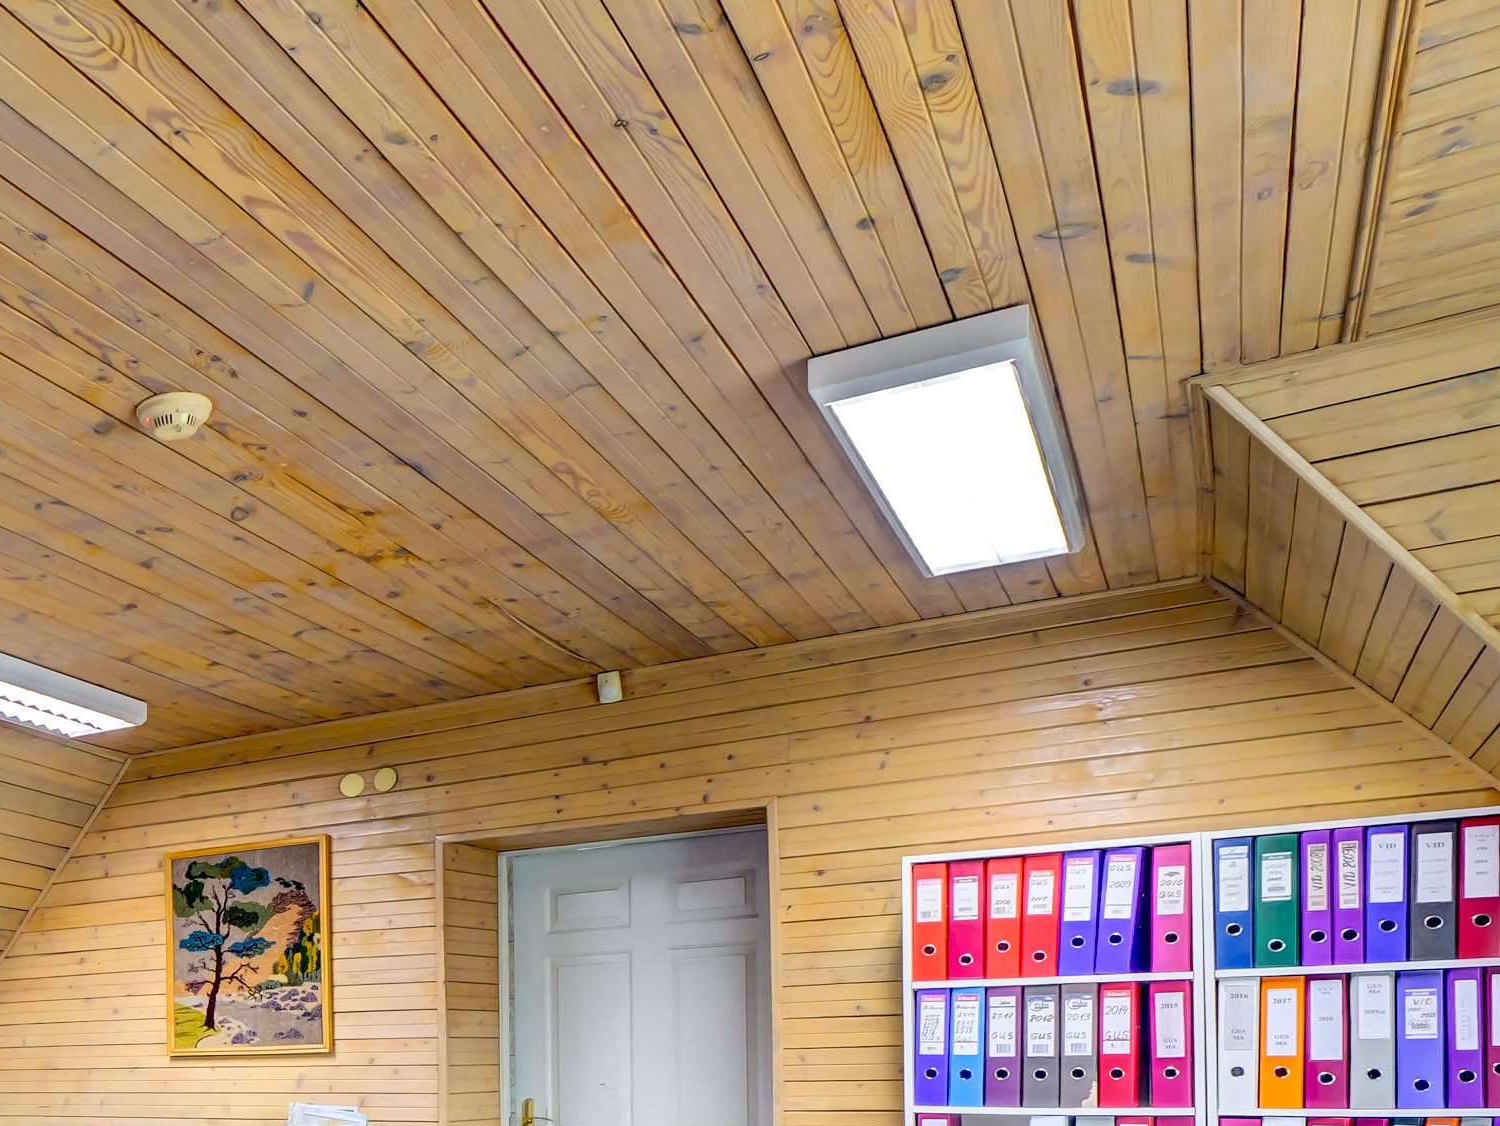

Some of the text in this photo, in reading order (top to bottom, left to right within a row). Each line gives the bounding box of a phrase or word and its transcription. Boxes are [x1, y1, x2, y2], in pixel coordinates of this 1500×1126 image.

[1109, 864, 1132, 872] GUS
[1108, 880, 1132, 889] 2009
[1159, 878, 1183, 887] 2010
[1310, 874, 1323, 892] VID
[1342, 871, 1356, 890] VID
[1158, 889, 1182, 899] GUS
[1412, 997, 1433, 1006] VID
[1104, 1005, 1129, 1015] 2014
[991, 1012, 1014, 1020] 2011
[1029, 1014, 1054, 1023] 2012
[1067, 1012, 1091, 1021] 2013
[990, 1031, 1014, 1040] GUS
[1029, 1032, 1053, 1041] GUS
[1065, 1031, 1087, 1040] GUS
[1104, 1030, 1129, 1040] GUS
